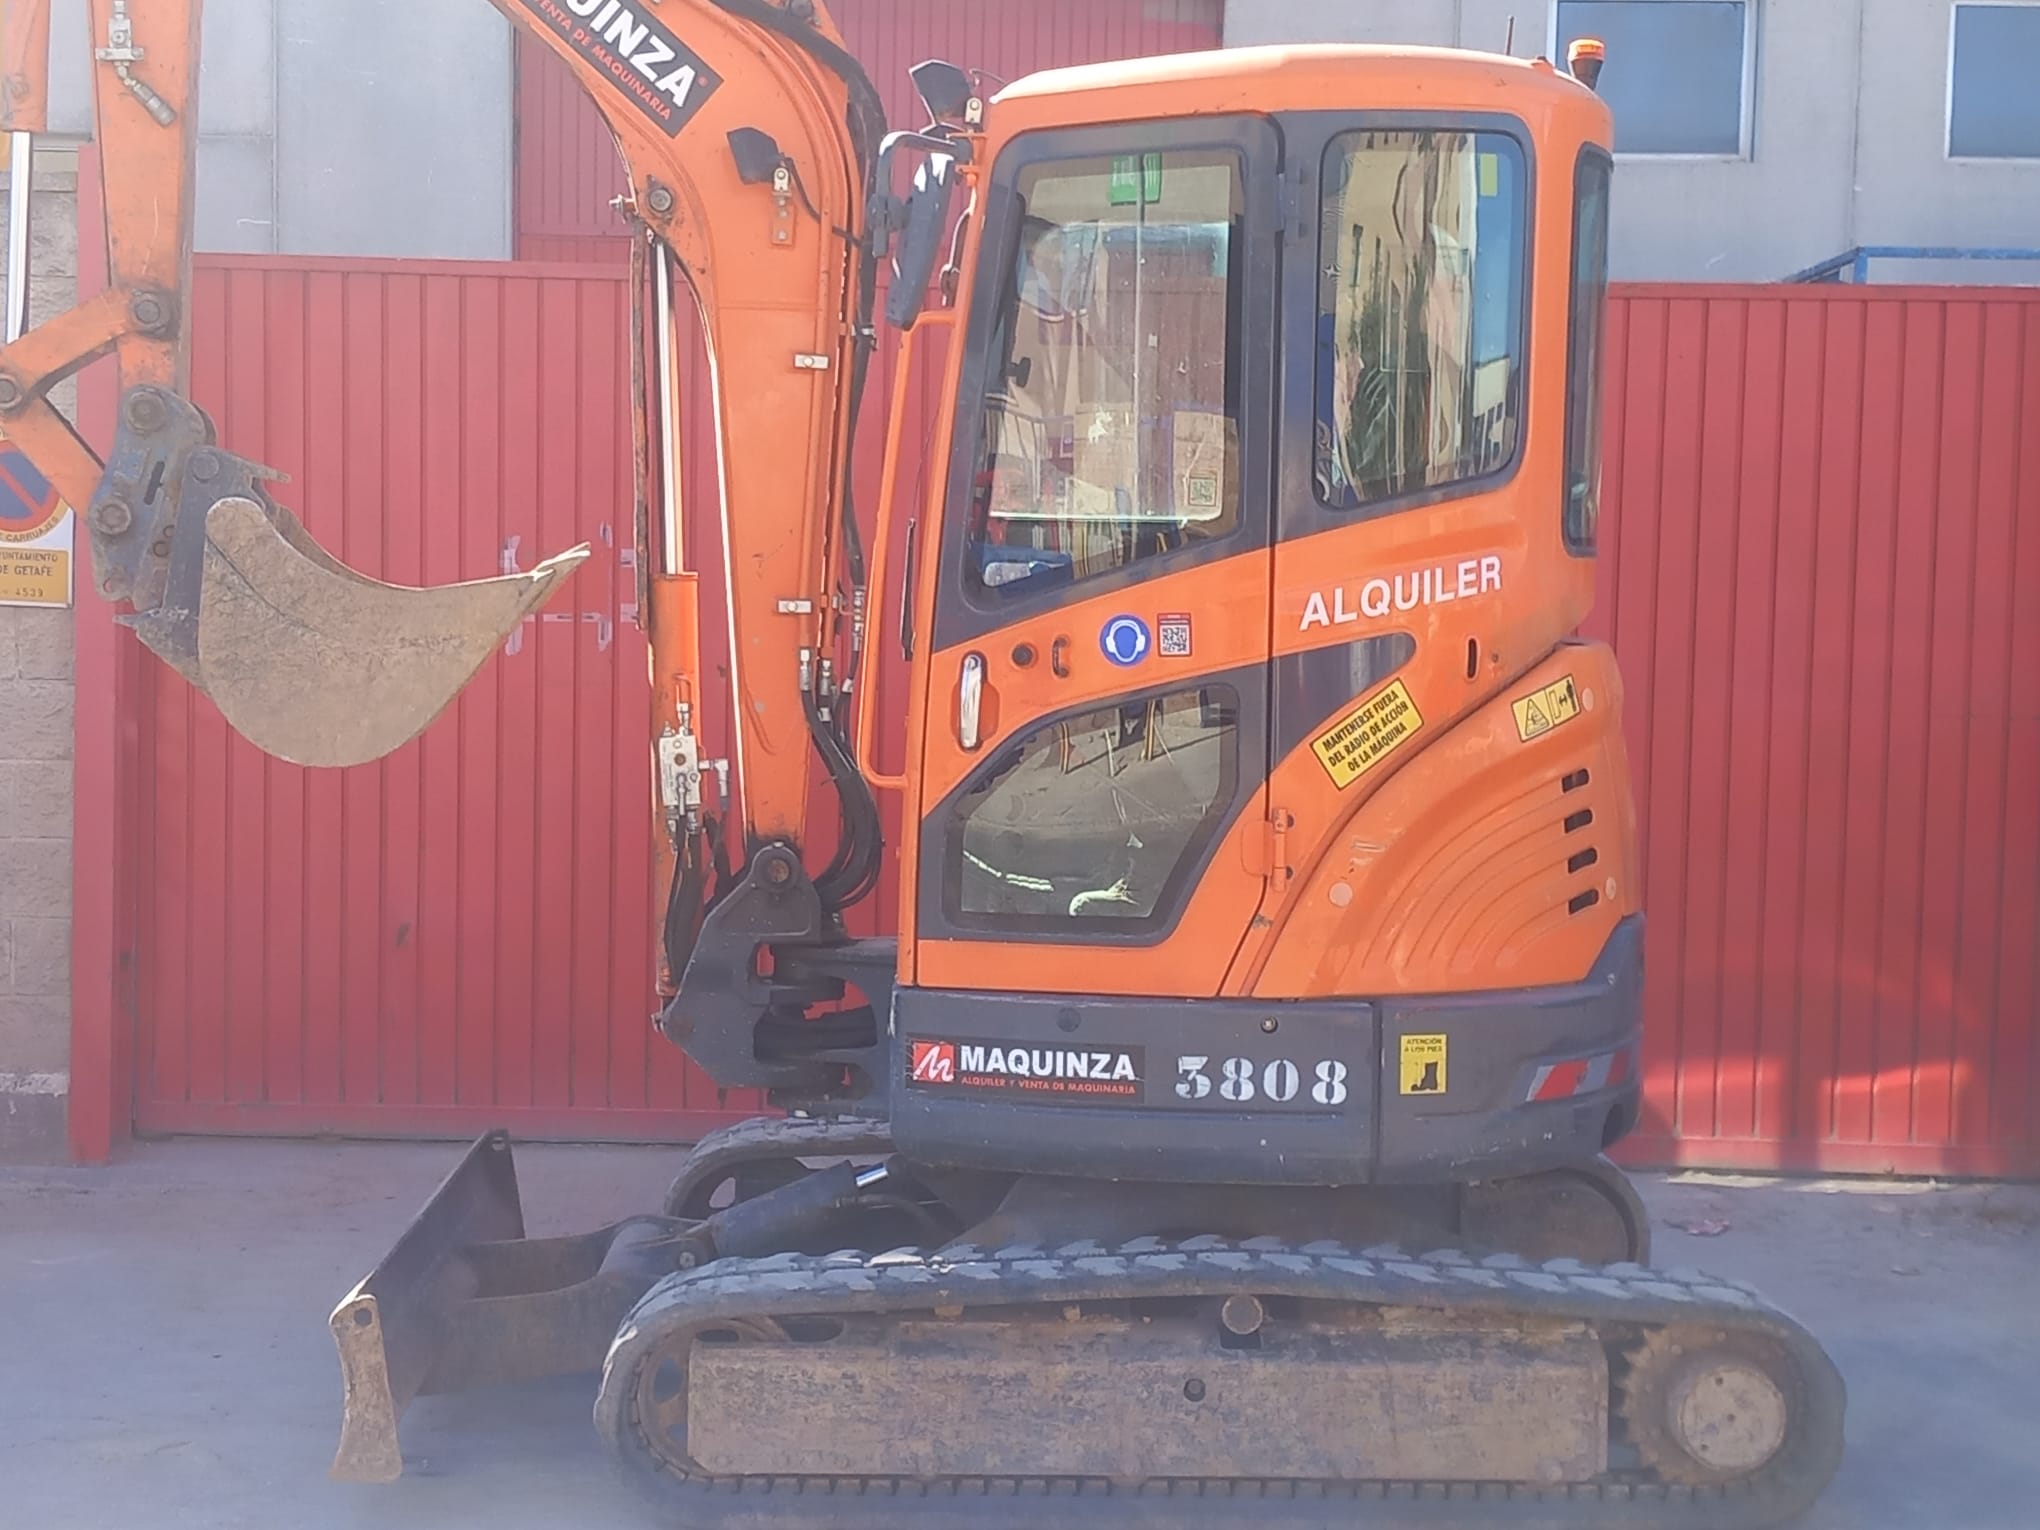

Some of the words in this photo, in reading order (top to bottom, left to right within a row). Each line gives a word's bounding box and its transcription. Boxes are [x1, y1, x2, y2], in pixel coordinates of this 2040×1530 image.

[535, 0, 573, 31] ENTA
[573, 28, 591, 47] DE
[591, 45, 671, 120] MAQUINARIA
[6, 516, 59, 543] CARRUAJES
[0, 551, 58, 562] UNTAMIENTO
[14, 565, 54, 577] GETAFE
[1299, 556, 1502, 632] ALQUILER
[1322, 707, 1375, 752] MANTENERSE
[1373, 689, 1400, 715] FUERA
[1328, 750, 1346, 768] DEL
[1344, 731, 1371, 756] RADIO
[1369, 722, 1382, 737] DE
[1380, 700, 1409, 728] ACCIÓN
[1347, 757, 1360, 772] DE
[1359, 750, 1372, 764] LA
[960, 1045, 1136, 1081] MAQUINZA
[1175, 1056, 1347, 1105] 3808
[961, 1076, 1006, 1087] ALQUILER
[1018, 1080, 1050, 1090] VENTA
[1052, 1081, 1065, 1090] DE
[1067, 1083, 1136, 1094] MAQUINARIA
